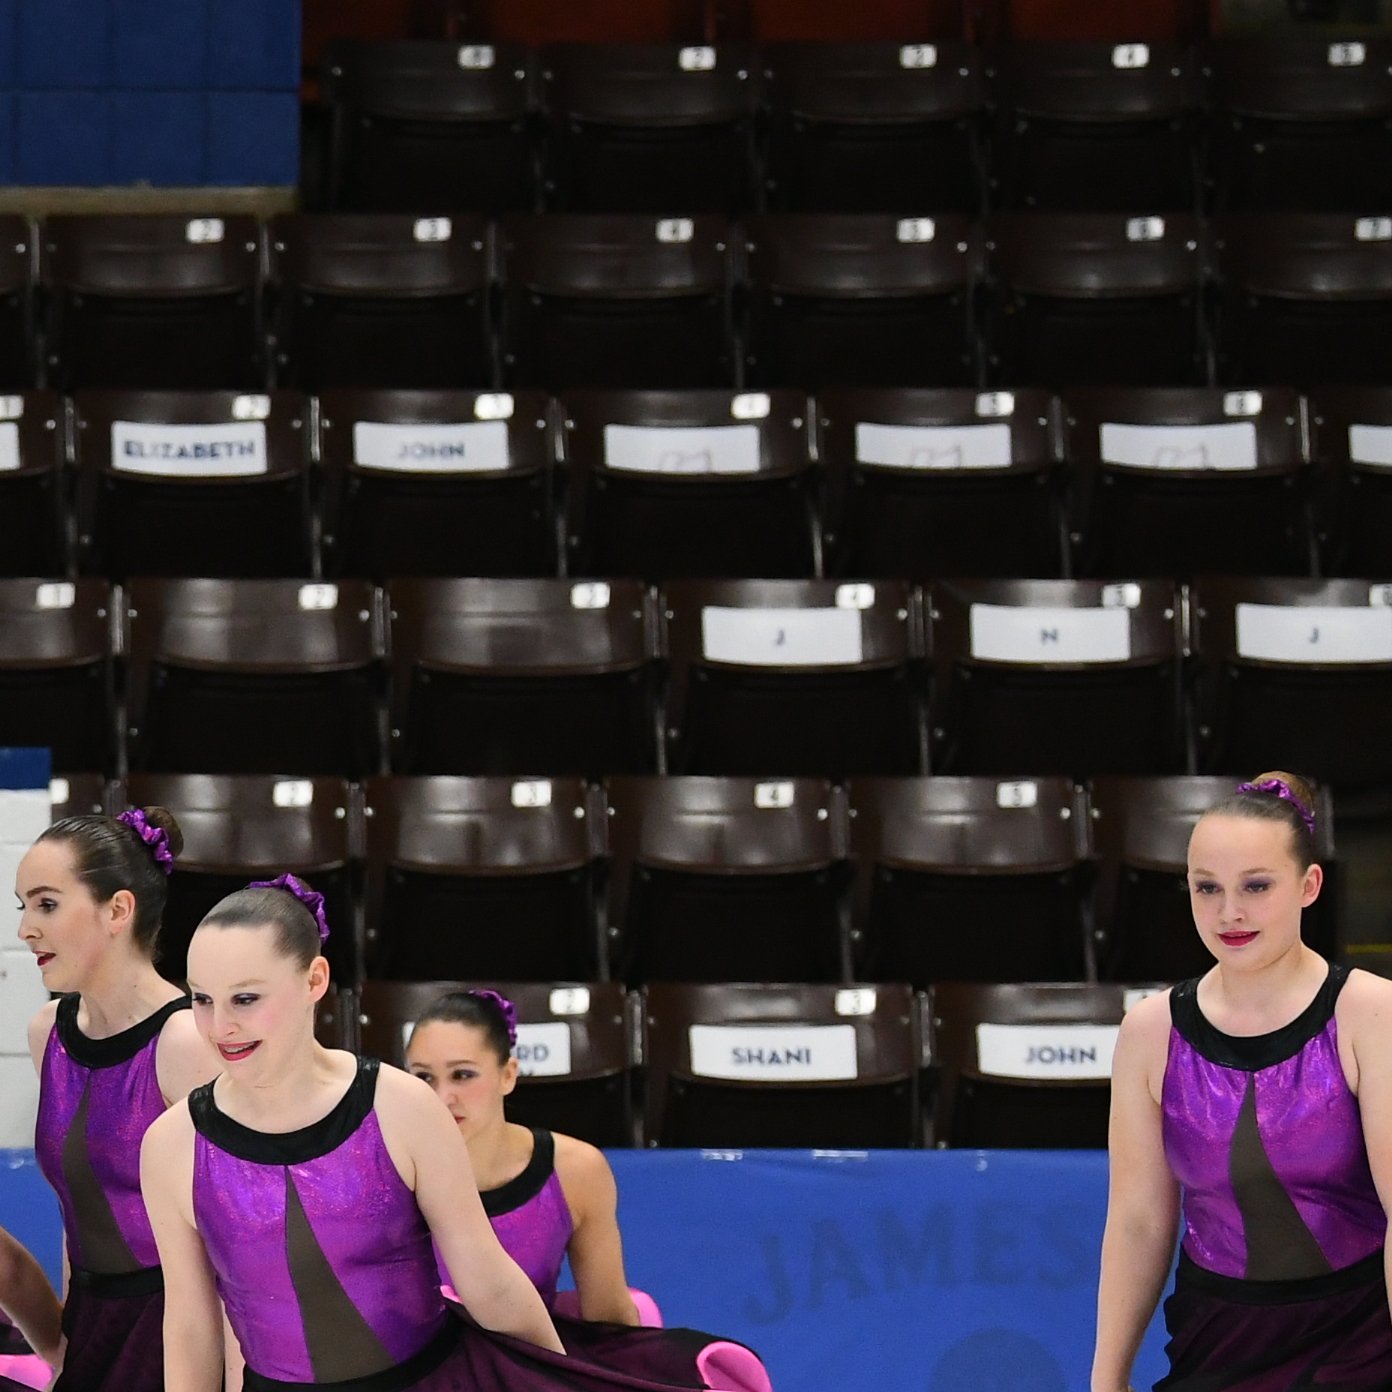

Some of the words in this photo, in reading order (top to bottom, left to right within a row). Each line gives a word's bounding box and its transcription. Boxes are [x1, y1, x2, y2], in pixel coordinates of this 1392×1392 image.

[122, 440, 256, 462] ELIZABETH
[398, 441, 466, 461] JOHN
[1040, 628, 1060, 646] N
[731, 1046, 812, 1066] SHANI
[1027, 1046, 1098, 1065] JOHN
